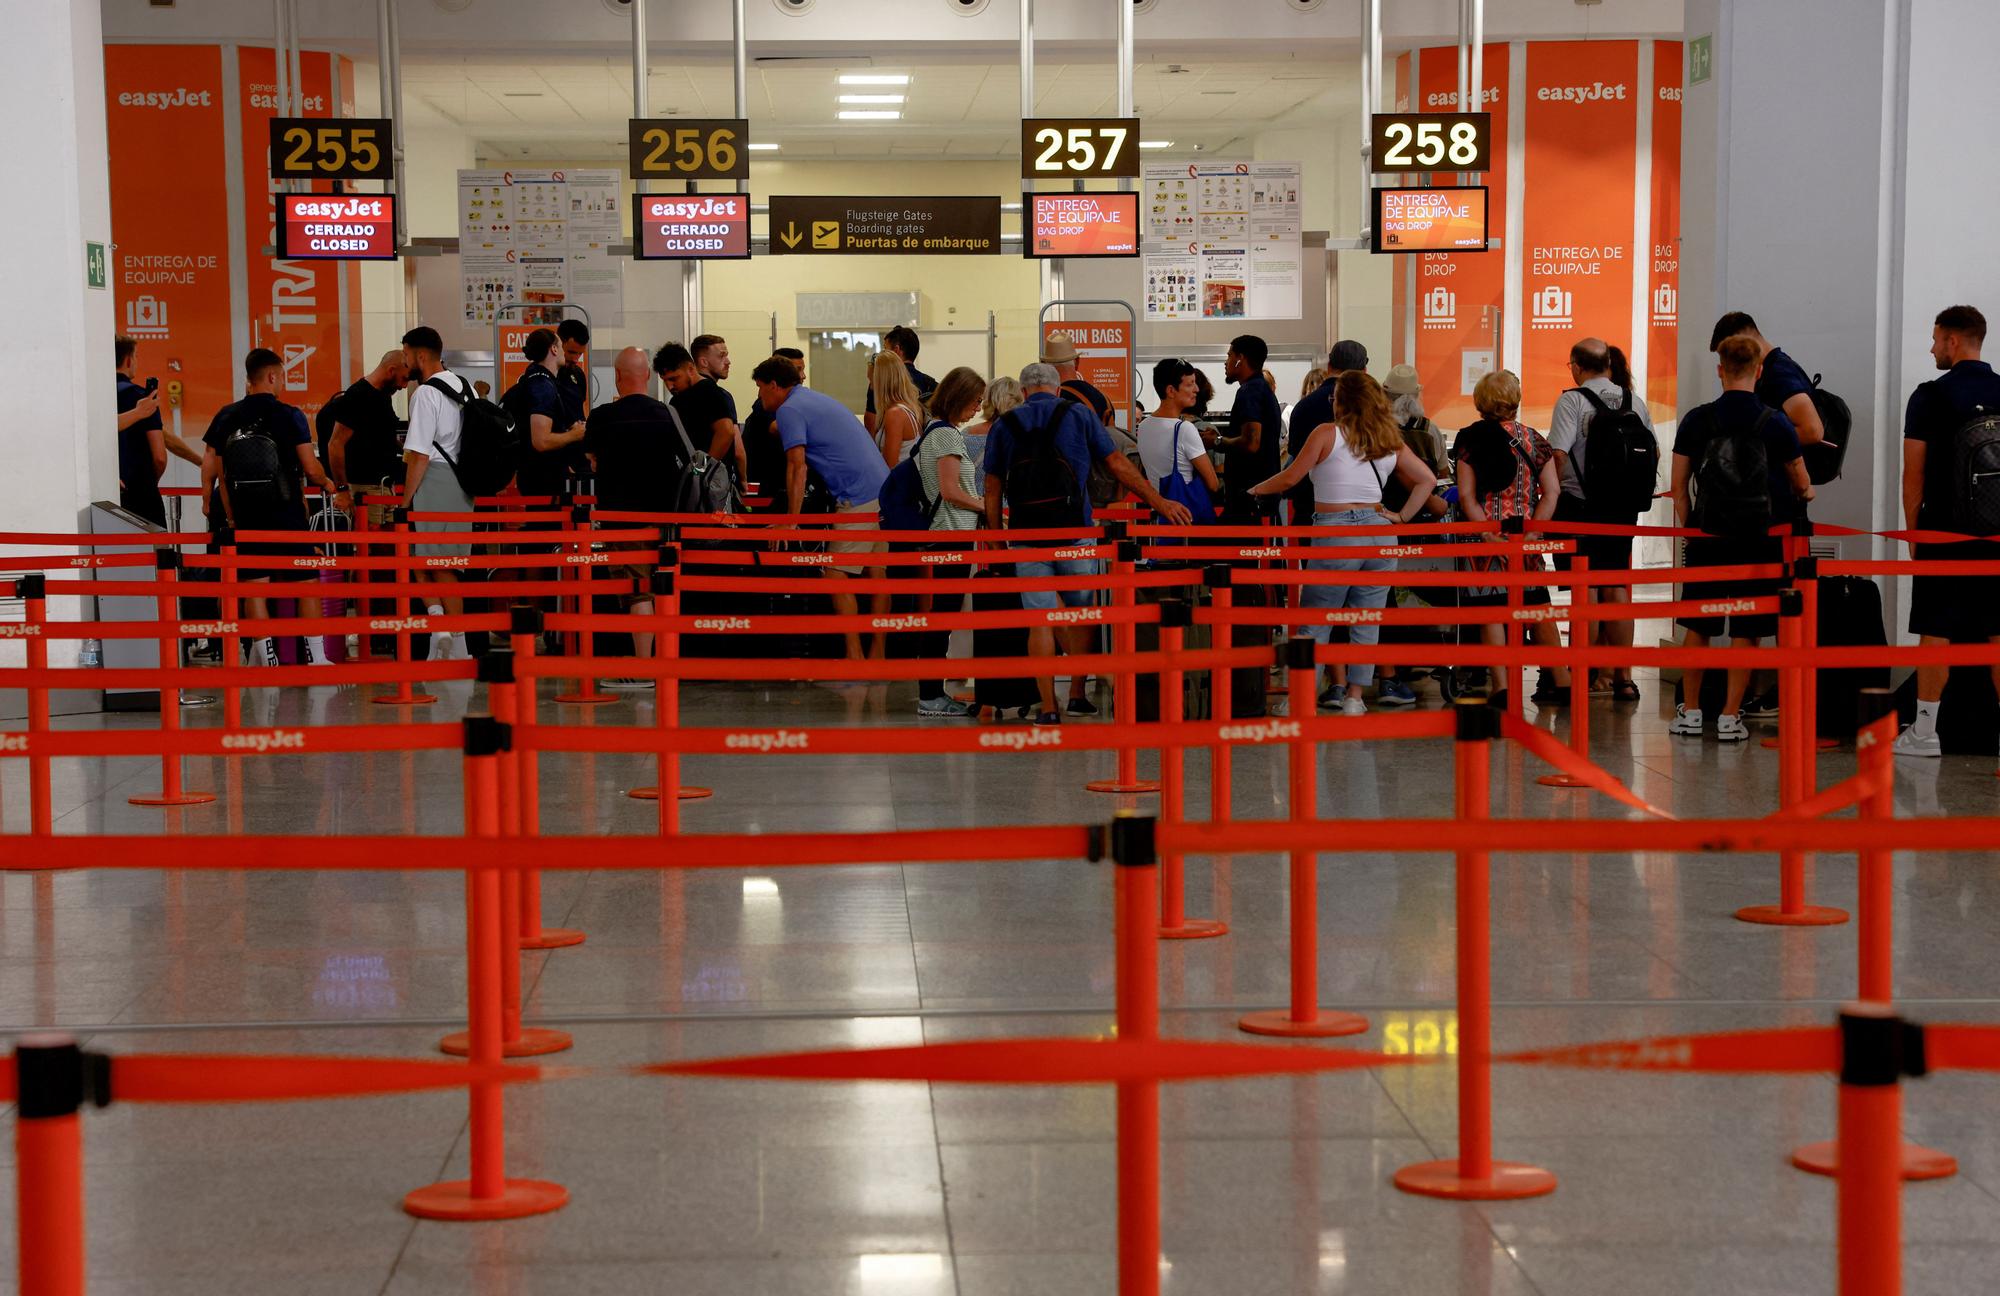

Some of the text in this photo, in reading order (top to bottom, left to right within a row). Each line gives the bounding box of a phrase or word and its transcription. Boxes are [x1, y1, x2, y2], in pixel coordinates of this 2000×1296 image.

[118, 88, 211, 110] easyJet
[1428, 86, 1500, 107] easet
[1537, 82, 1627, 104] easyJet
[283, 127, 380, 172] 255
[642, 128, 737, 172] 256
[1034, 128, 1127, 171] 257
[1383, 122, 1478, 166] 258
[1037, 199, 1099, 211] ENTREGA
[1385, 194, 1448, 207] ENTREGA
[295, 199, 382, 220] easyJet
[651, 199, 736, 219] easyJet
[1385, 206, 1470, 219] DE EQUIPAJE
[846, 210, 933, 222] Flugsteige Gates
[1037, 211, 1121, 224] DE EQUIPAJE
[304, 224, 375, 236] CERRADO
[660, 224, 730, 235] CERRADO
[846, 223, 925, 235] Boarding gates
[1037, 226, 1085, 236] BAG DROP
[1385, 221, 1433, 231] BAG DROP
[310, 239, 369, 251] CLOSED
[666, 239, 724, 250] CLOSED
[846, 236, 990, 250] Puertas de embarque
[1533, 246, 1623, 259] ENTREGA DE
[1655, 244, 1672, 257] BAG
[124, 256, 217, 268] ENTREGA DE
[1654, 260, 1678, 273] DROP
[1424, 264, 1457, 276] DROP
[1533, 263, 1601, 275] EQUIPAJE
[125, 272, 196, 284] EQUIPAJE
[1091, 328, 1122, 344] BAGS
[1054, 547, 1097, 560] easyJet
[1239, 547, 1282, 559] easyJet
[1379, 545, 1423, 557] easyJet
[1522, 541, 1565, 554] easyJet
[293, 556, 337, 568] easyJet
[426, 556, 470, 568] easyJet
[566, 553, 609, 564] easyJet
[791, 553, 834, 565] easyJet
[921, 552, 963, 564] easyJet
[1701, 599, 1756, 614] easyJet
[1047, 608, 1103, 622] easyJet
[1326, 609, 1383, 622] easyJet
[1513, 606, 1569, 621] easyJet
[180, 621, 239, 635] easyJet
[370, 617, 428, 631] easyJet
[694, 617, 751, 631] easyJet
[872, 616, 929, 630] easyJet
[1218, 719, 1301, 742] easyJet
[222, 730, 305, 752] easyJet
[725, 730, 809, 752] easyJet
[979, 726, 1062, 749] easyJet
